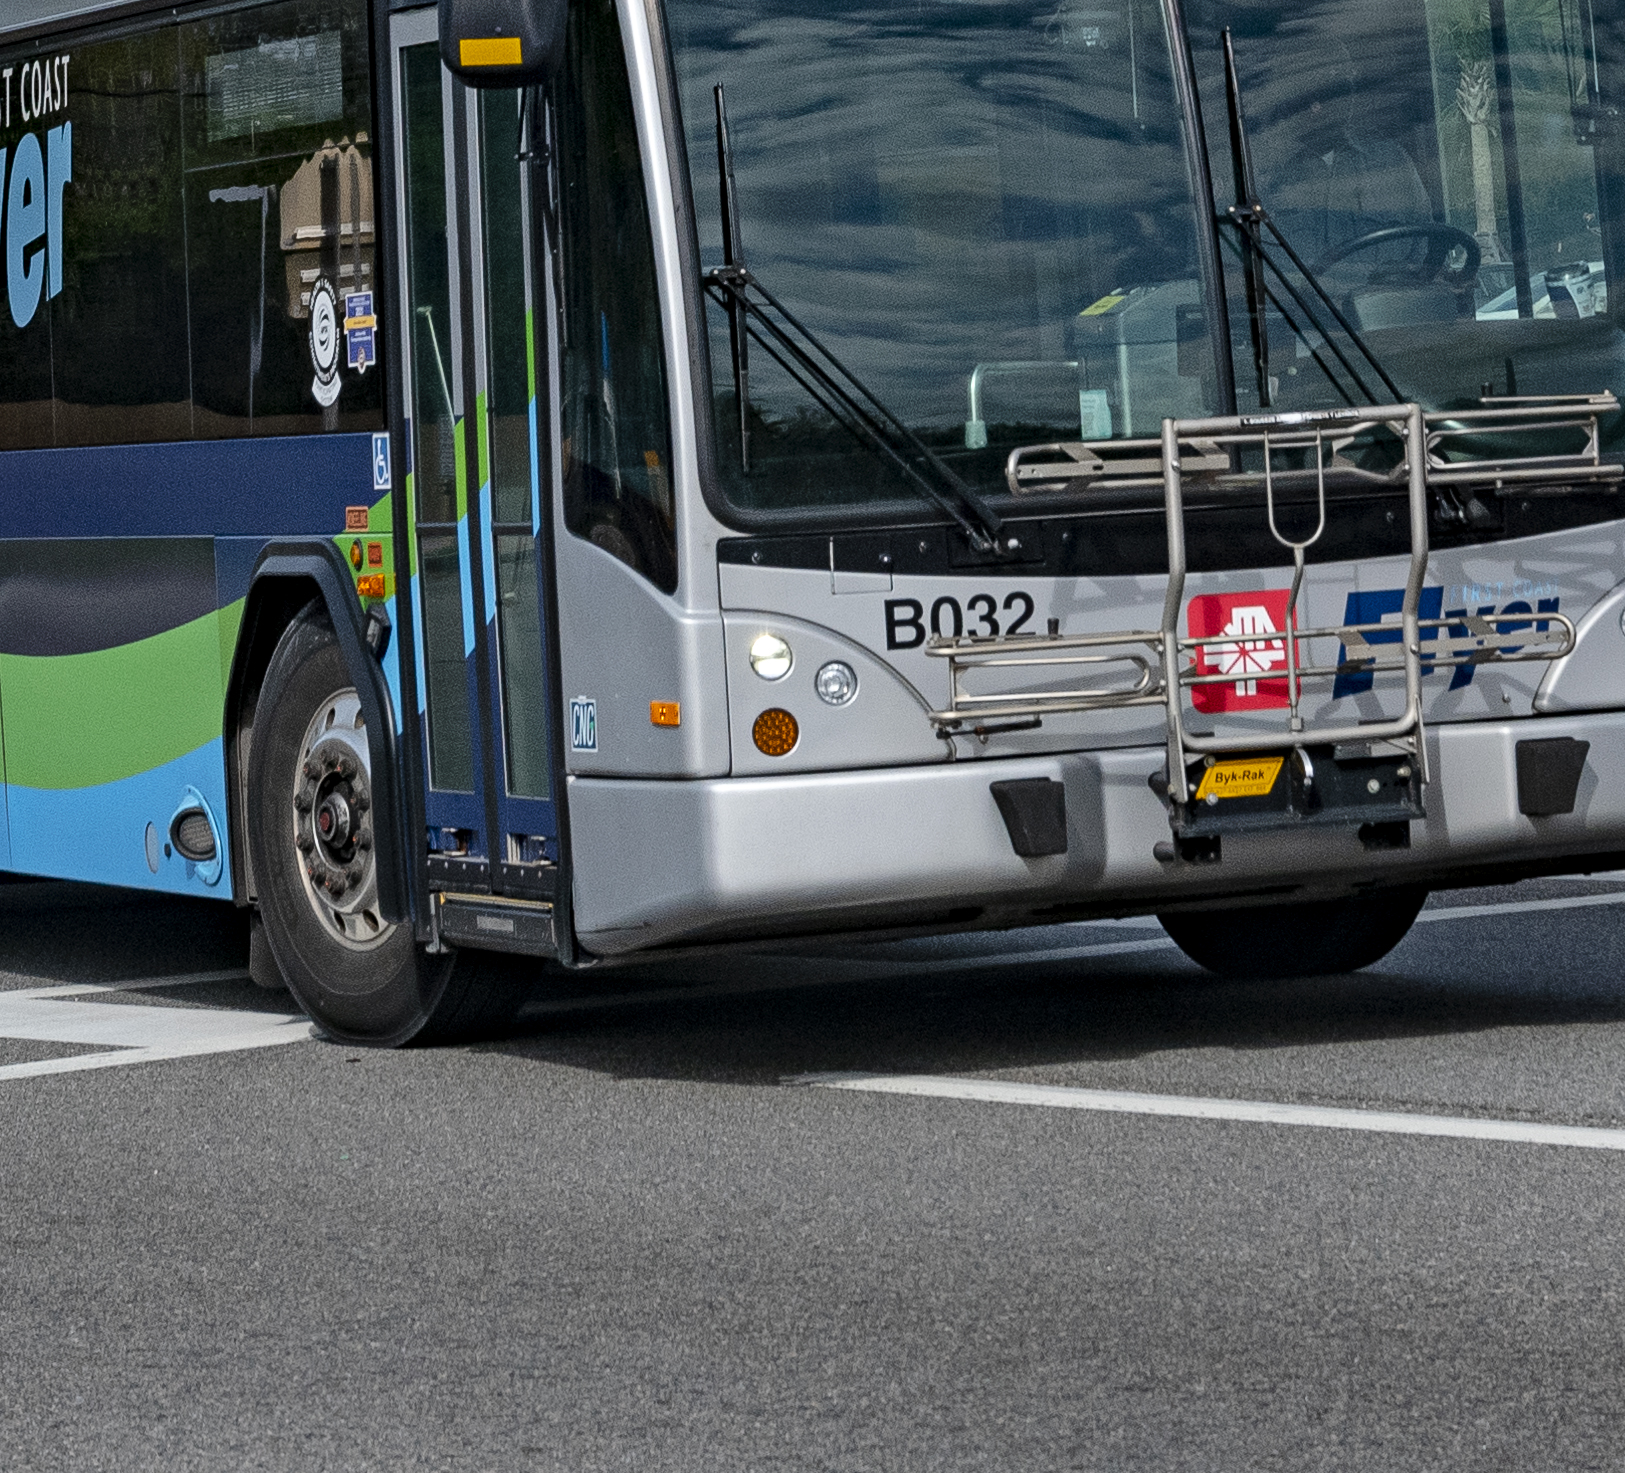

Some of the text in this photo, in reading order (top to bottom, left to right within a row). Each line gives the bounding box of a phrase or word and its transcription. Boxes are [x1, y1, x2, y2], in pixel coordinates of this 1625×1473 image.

[20, 54, 70, 122] COAST
[1450, 578, 1561, 604] FIRST COAST
[884, 591, 1036, 651] B032
[573, 705, 594, 746] CNG
